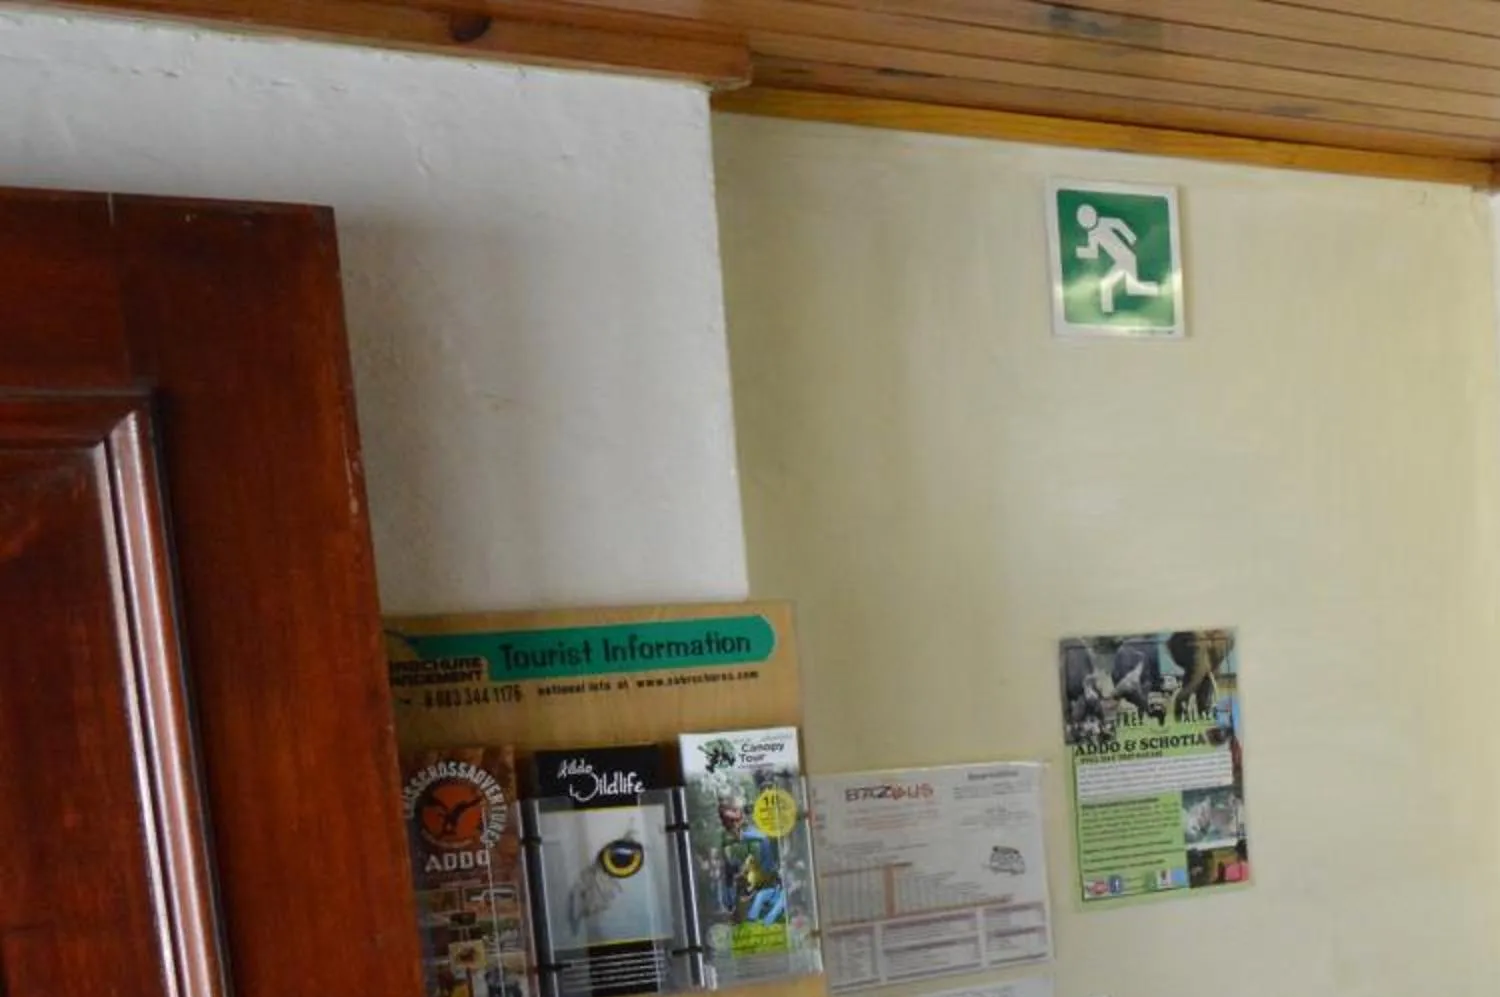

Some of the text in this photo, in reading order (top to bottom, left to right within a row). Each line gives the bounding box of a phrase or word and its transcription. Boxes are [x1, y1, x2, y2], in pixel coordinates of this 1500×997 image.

[498, 631, 752, 671] Tourist Information
[1074, 740, 1120, 756] ADDO
[1123, 739, 1137, 752] &
[569, 771, 646, 802] Wildlife
[424, 849, 490, 872] ADDO
